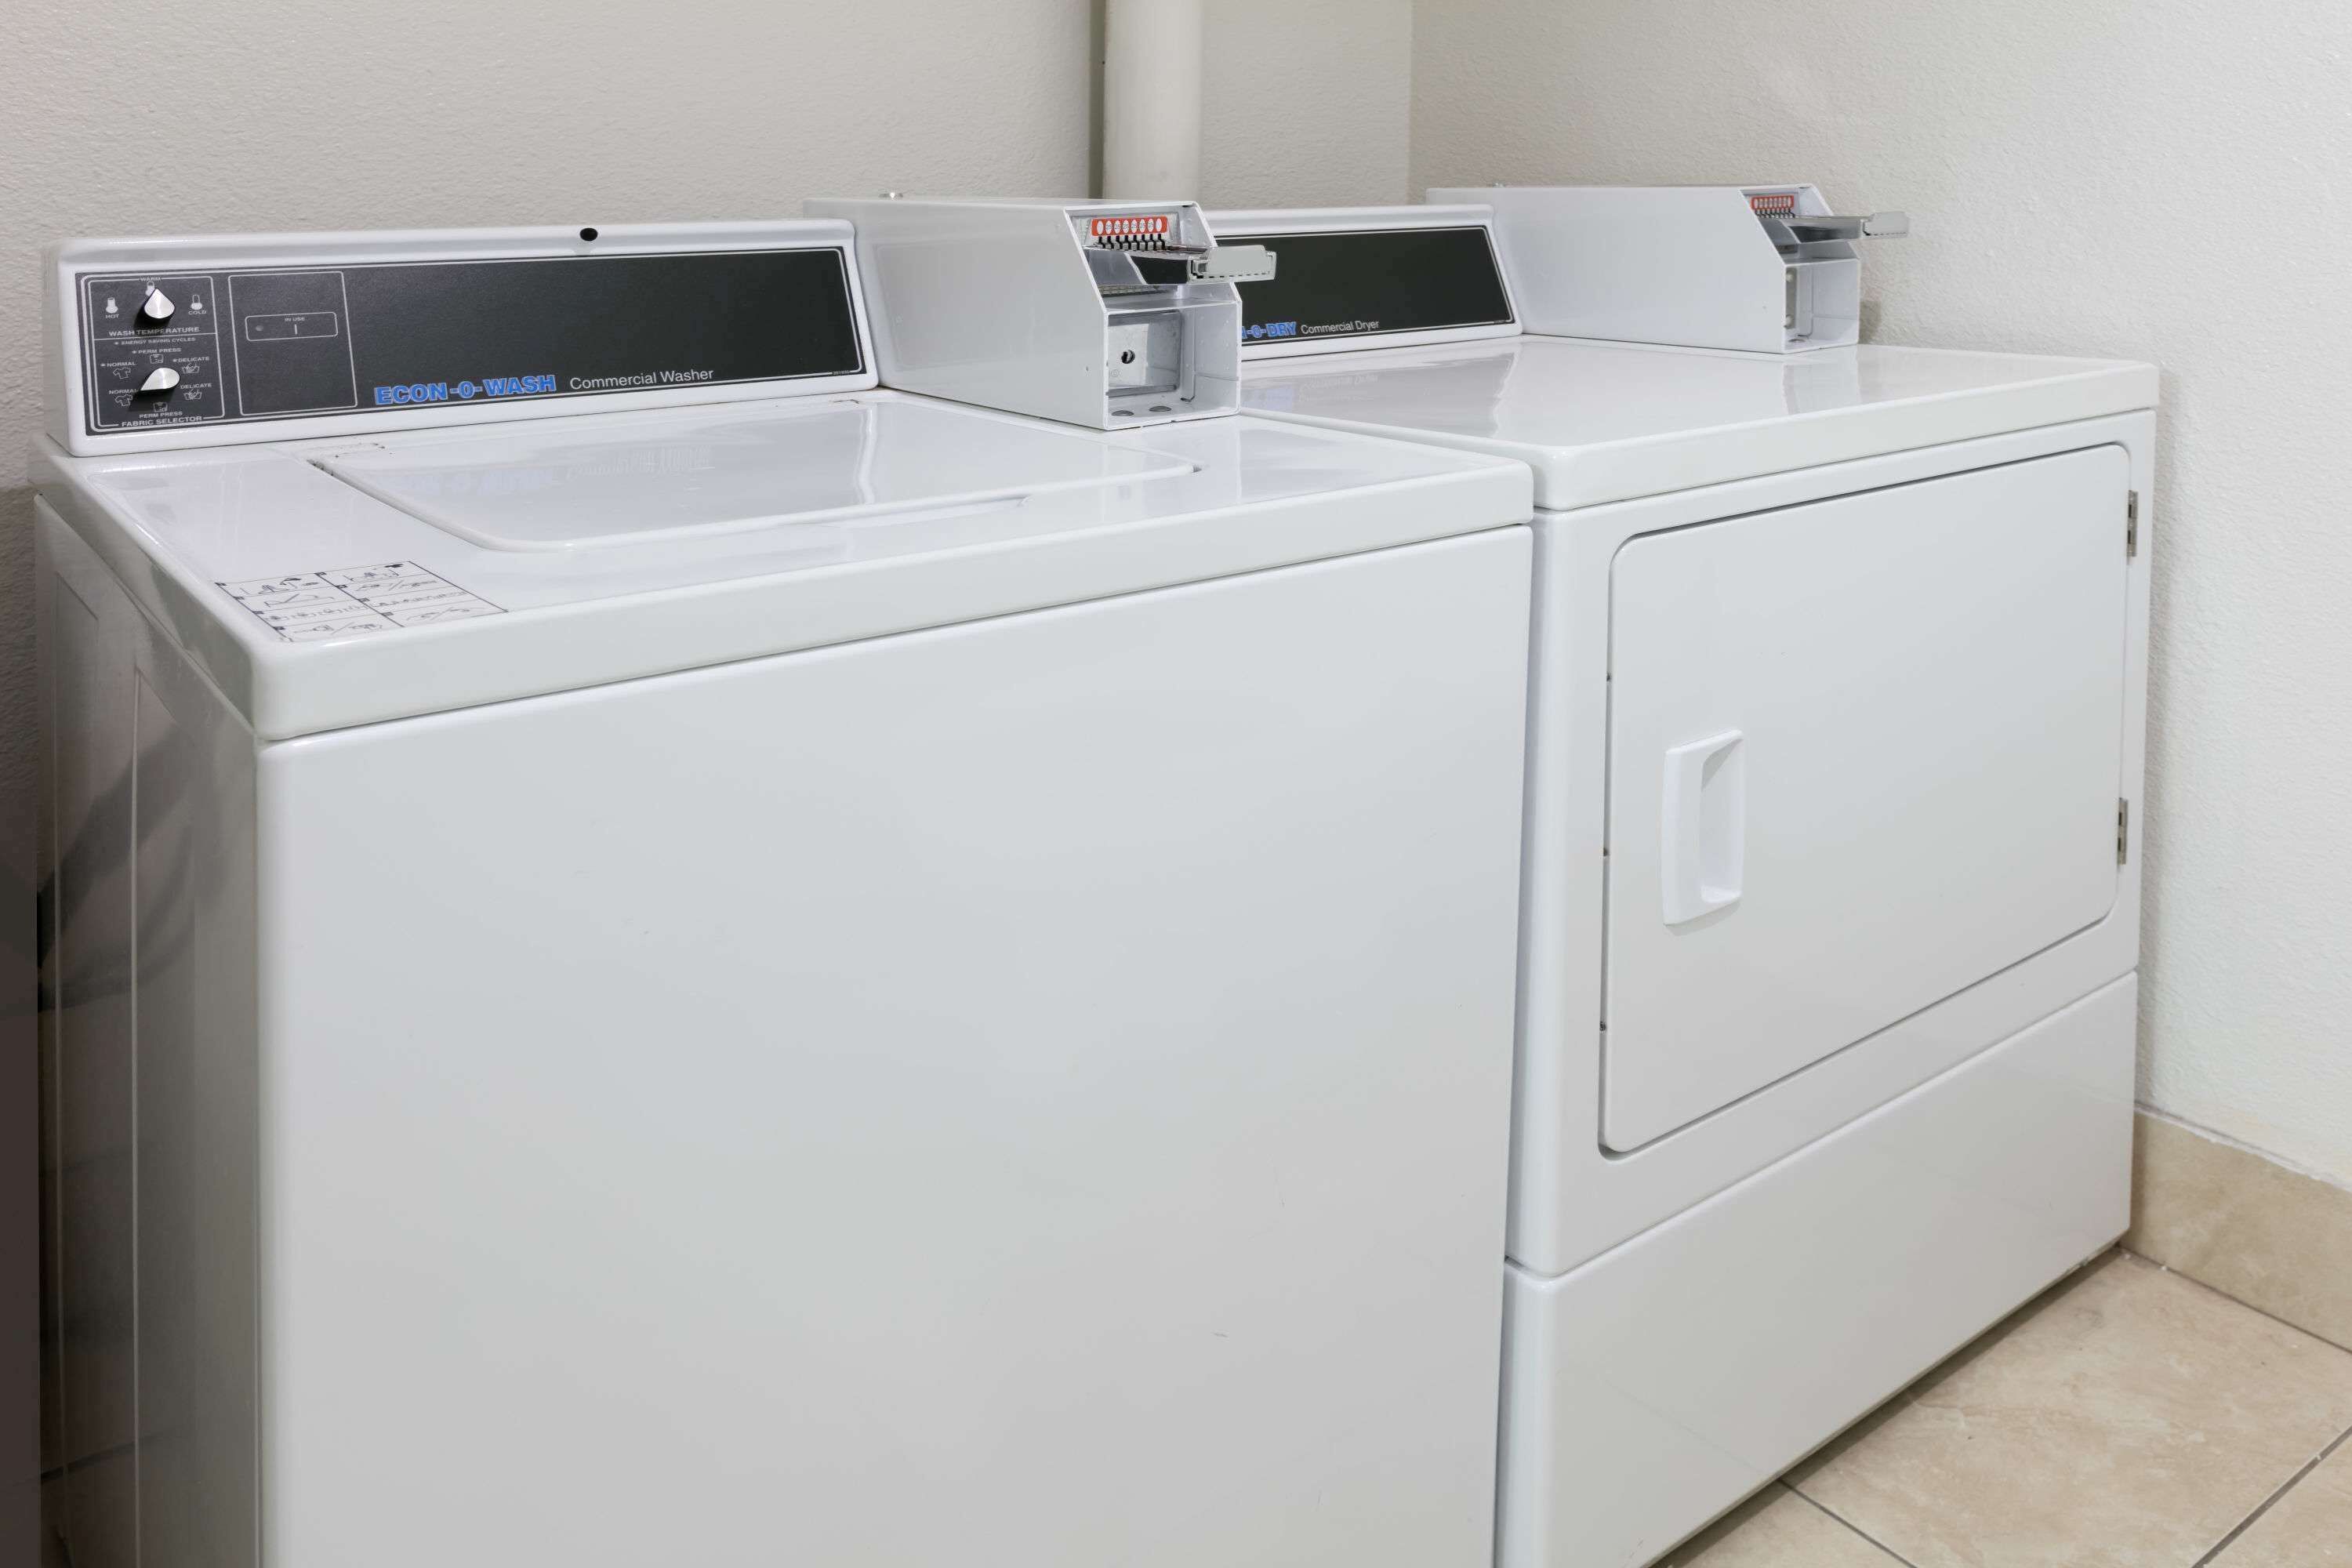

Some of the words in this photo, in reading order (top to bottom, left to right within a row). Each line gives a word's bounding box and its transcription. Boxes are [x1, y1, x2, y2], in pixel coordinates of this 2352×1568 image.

[136, 326, 200, 336] TEMPERATURE
[1301, 321, 1355, 335] Commercial
[1356, 320, 1380, 332] Dryer
[374, 374, 557, 406] ECON-O-WASH
[569, 372, 657, 390] Commercial
[659, 368, 713, 383] Washer
[122, 419, 154, 428] FABRIC
[156, 416, 202, 425] SELECTOR
